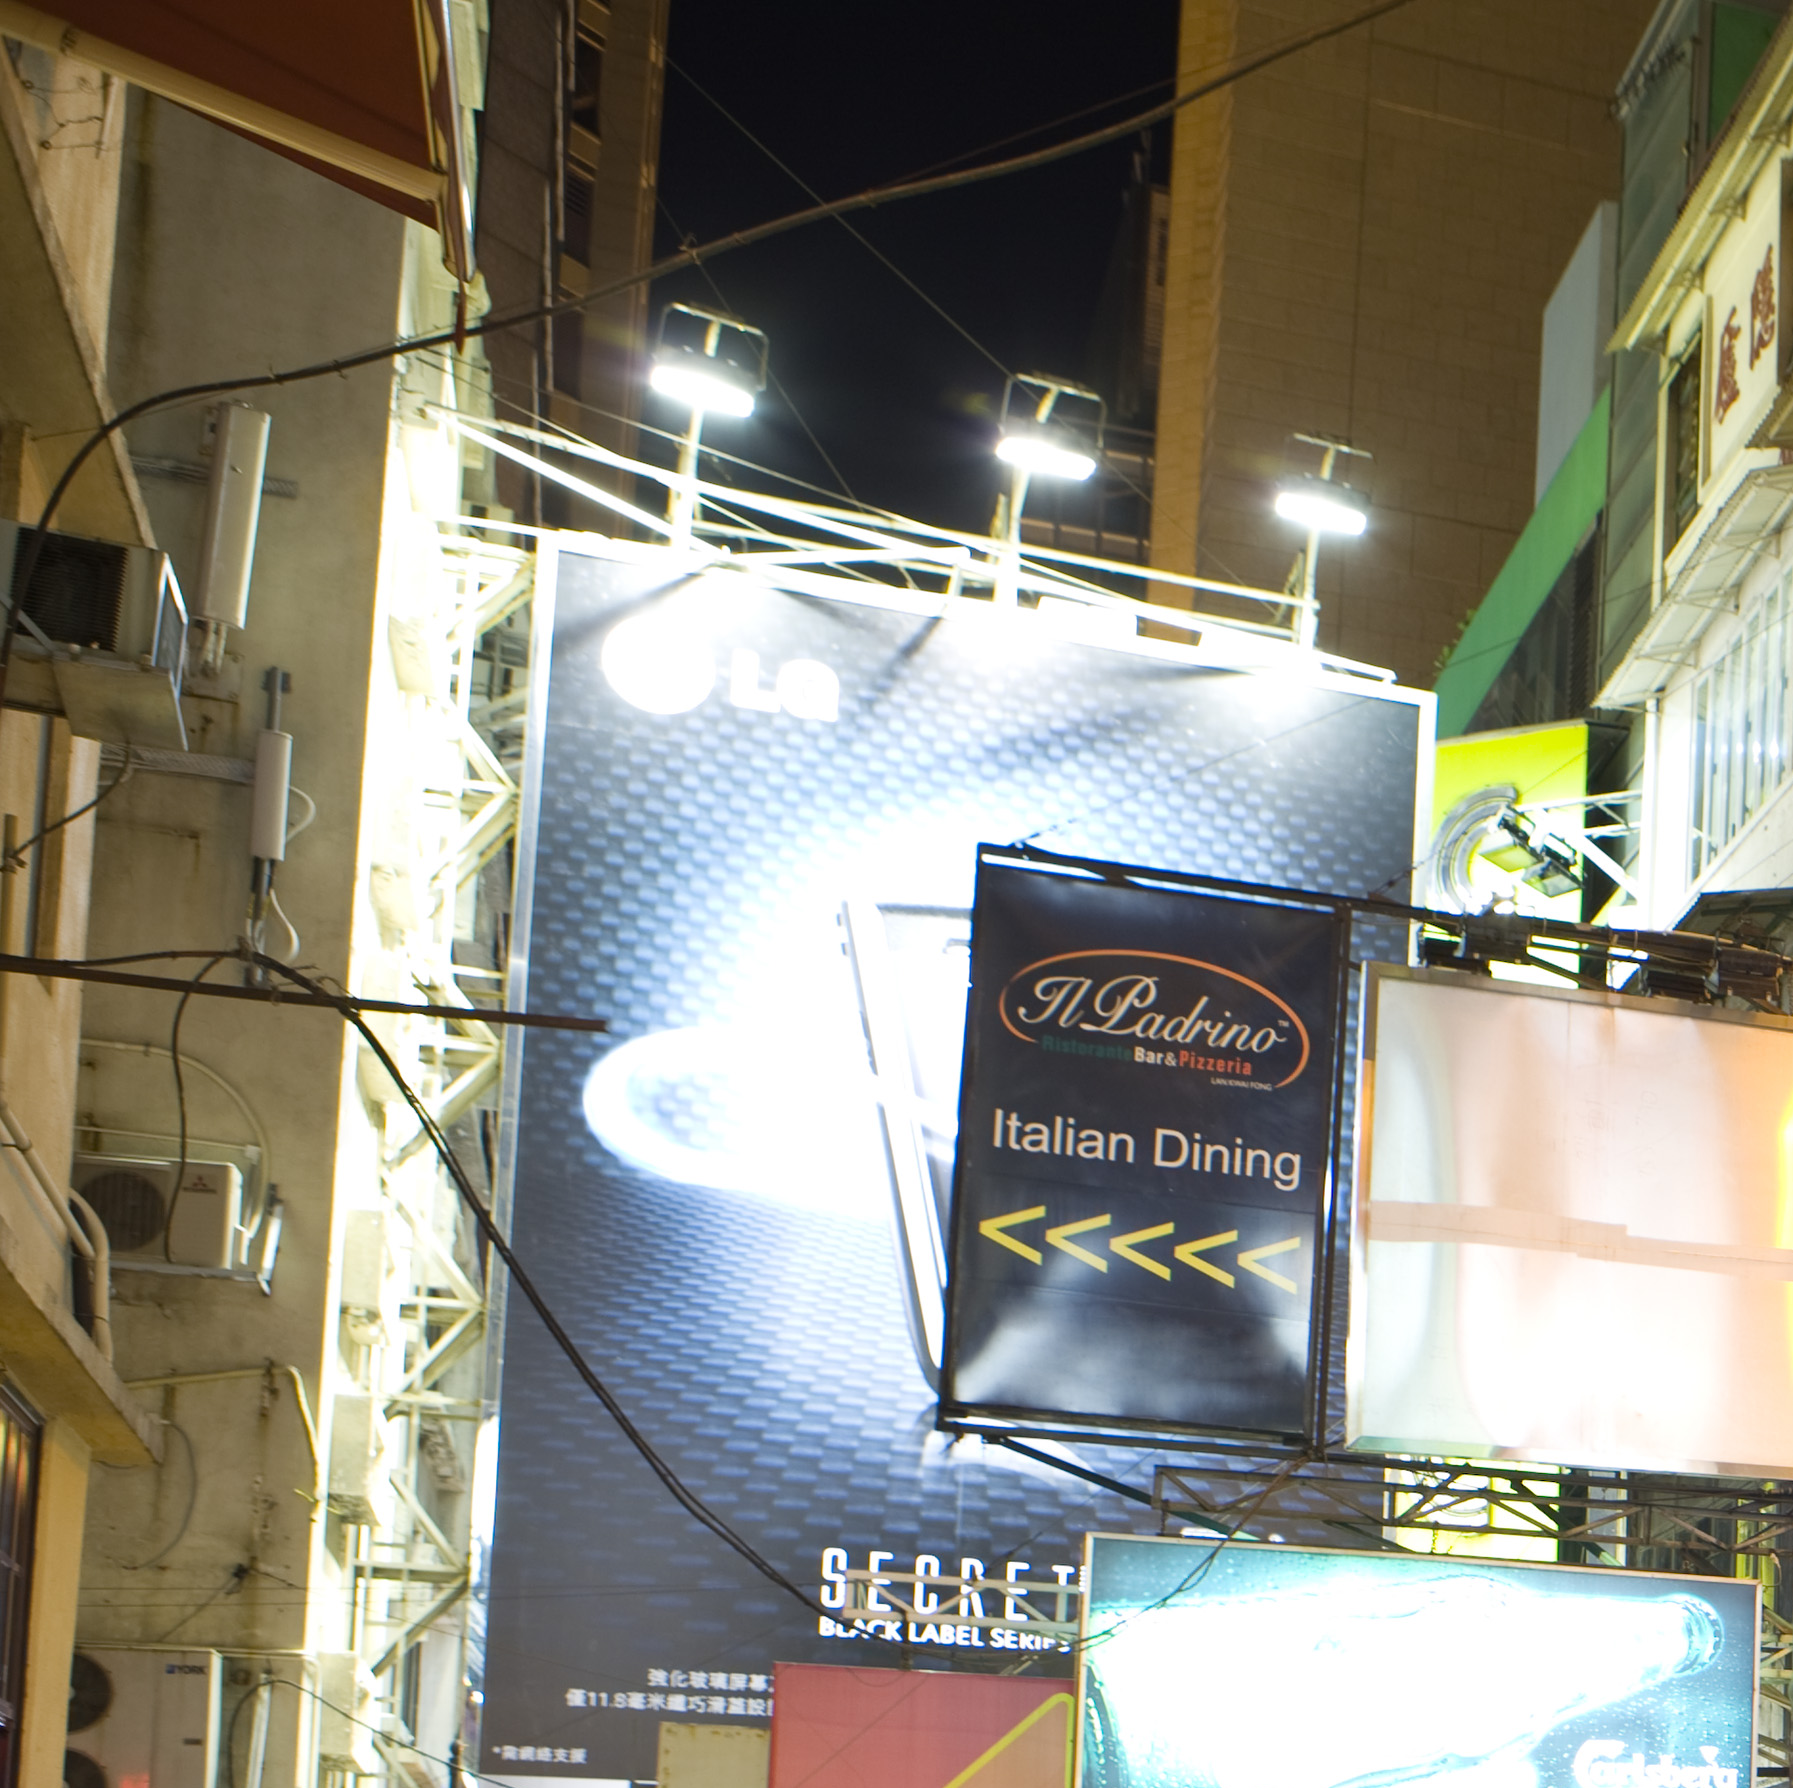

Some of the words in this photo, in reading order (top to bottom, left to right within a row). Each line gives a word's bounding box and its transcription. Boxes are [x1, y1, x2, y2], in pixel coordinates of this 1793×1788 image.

[1079, 974, 1287, 1053] Padrino
[992, 1108, 1135, 1164] Italian
[1154, 1127, 1301, 1192] Dining
[908, 1622, 986, 1648] LABEL
